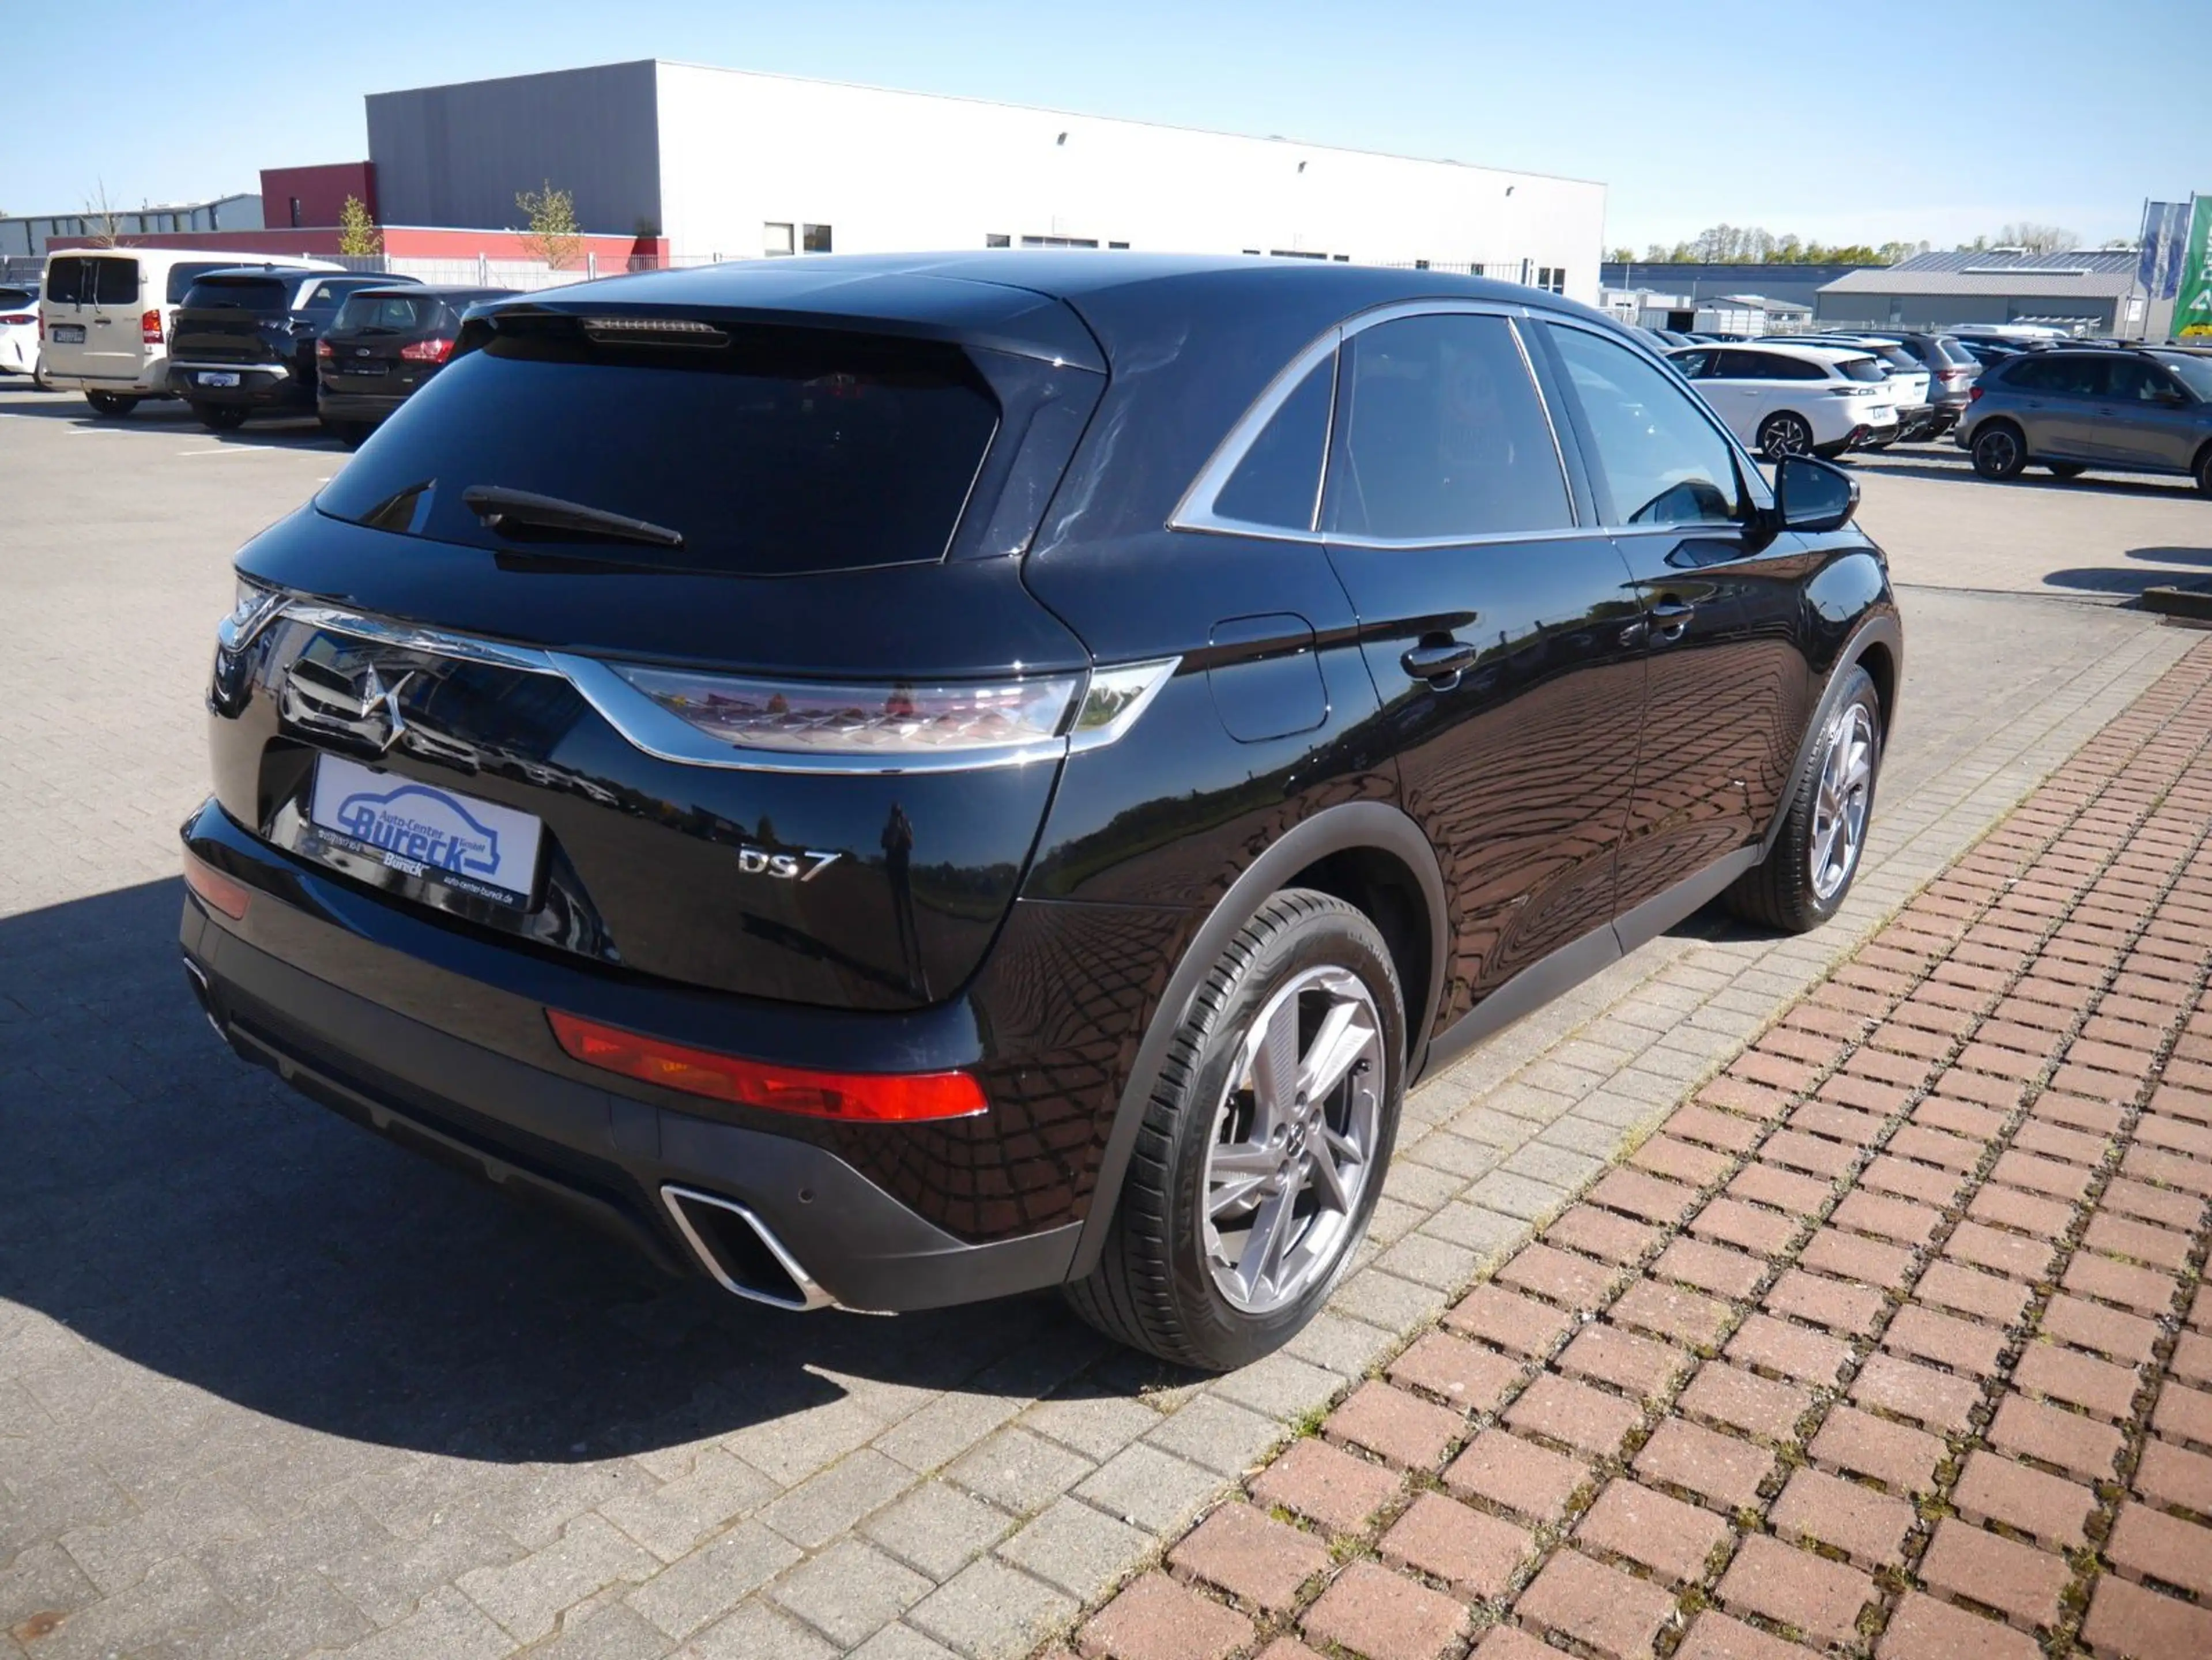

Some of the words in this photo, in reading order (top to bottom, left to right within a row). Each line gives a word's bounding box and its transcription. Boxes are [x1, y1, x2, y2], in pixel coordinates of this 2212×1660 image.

[379, 810, 444, 839] Auto-Center
[353, 806, 468, 873] Bureck
[384, 853, 423, 877] Bureck
